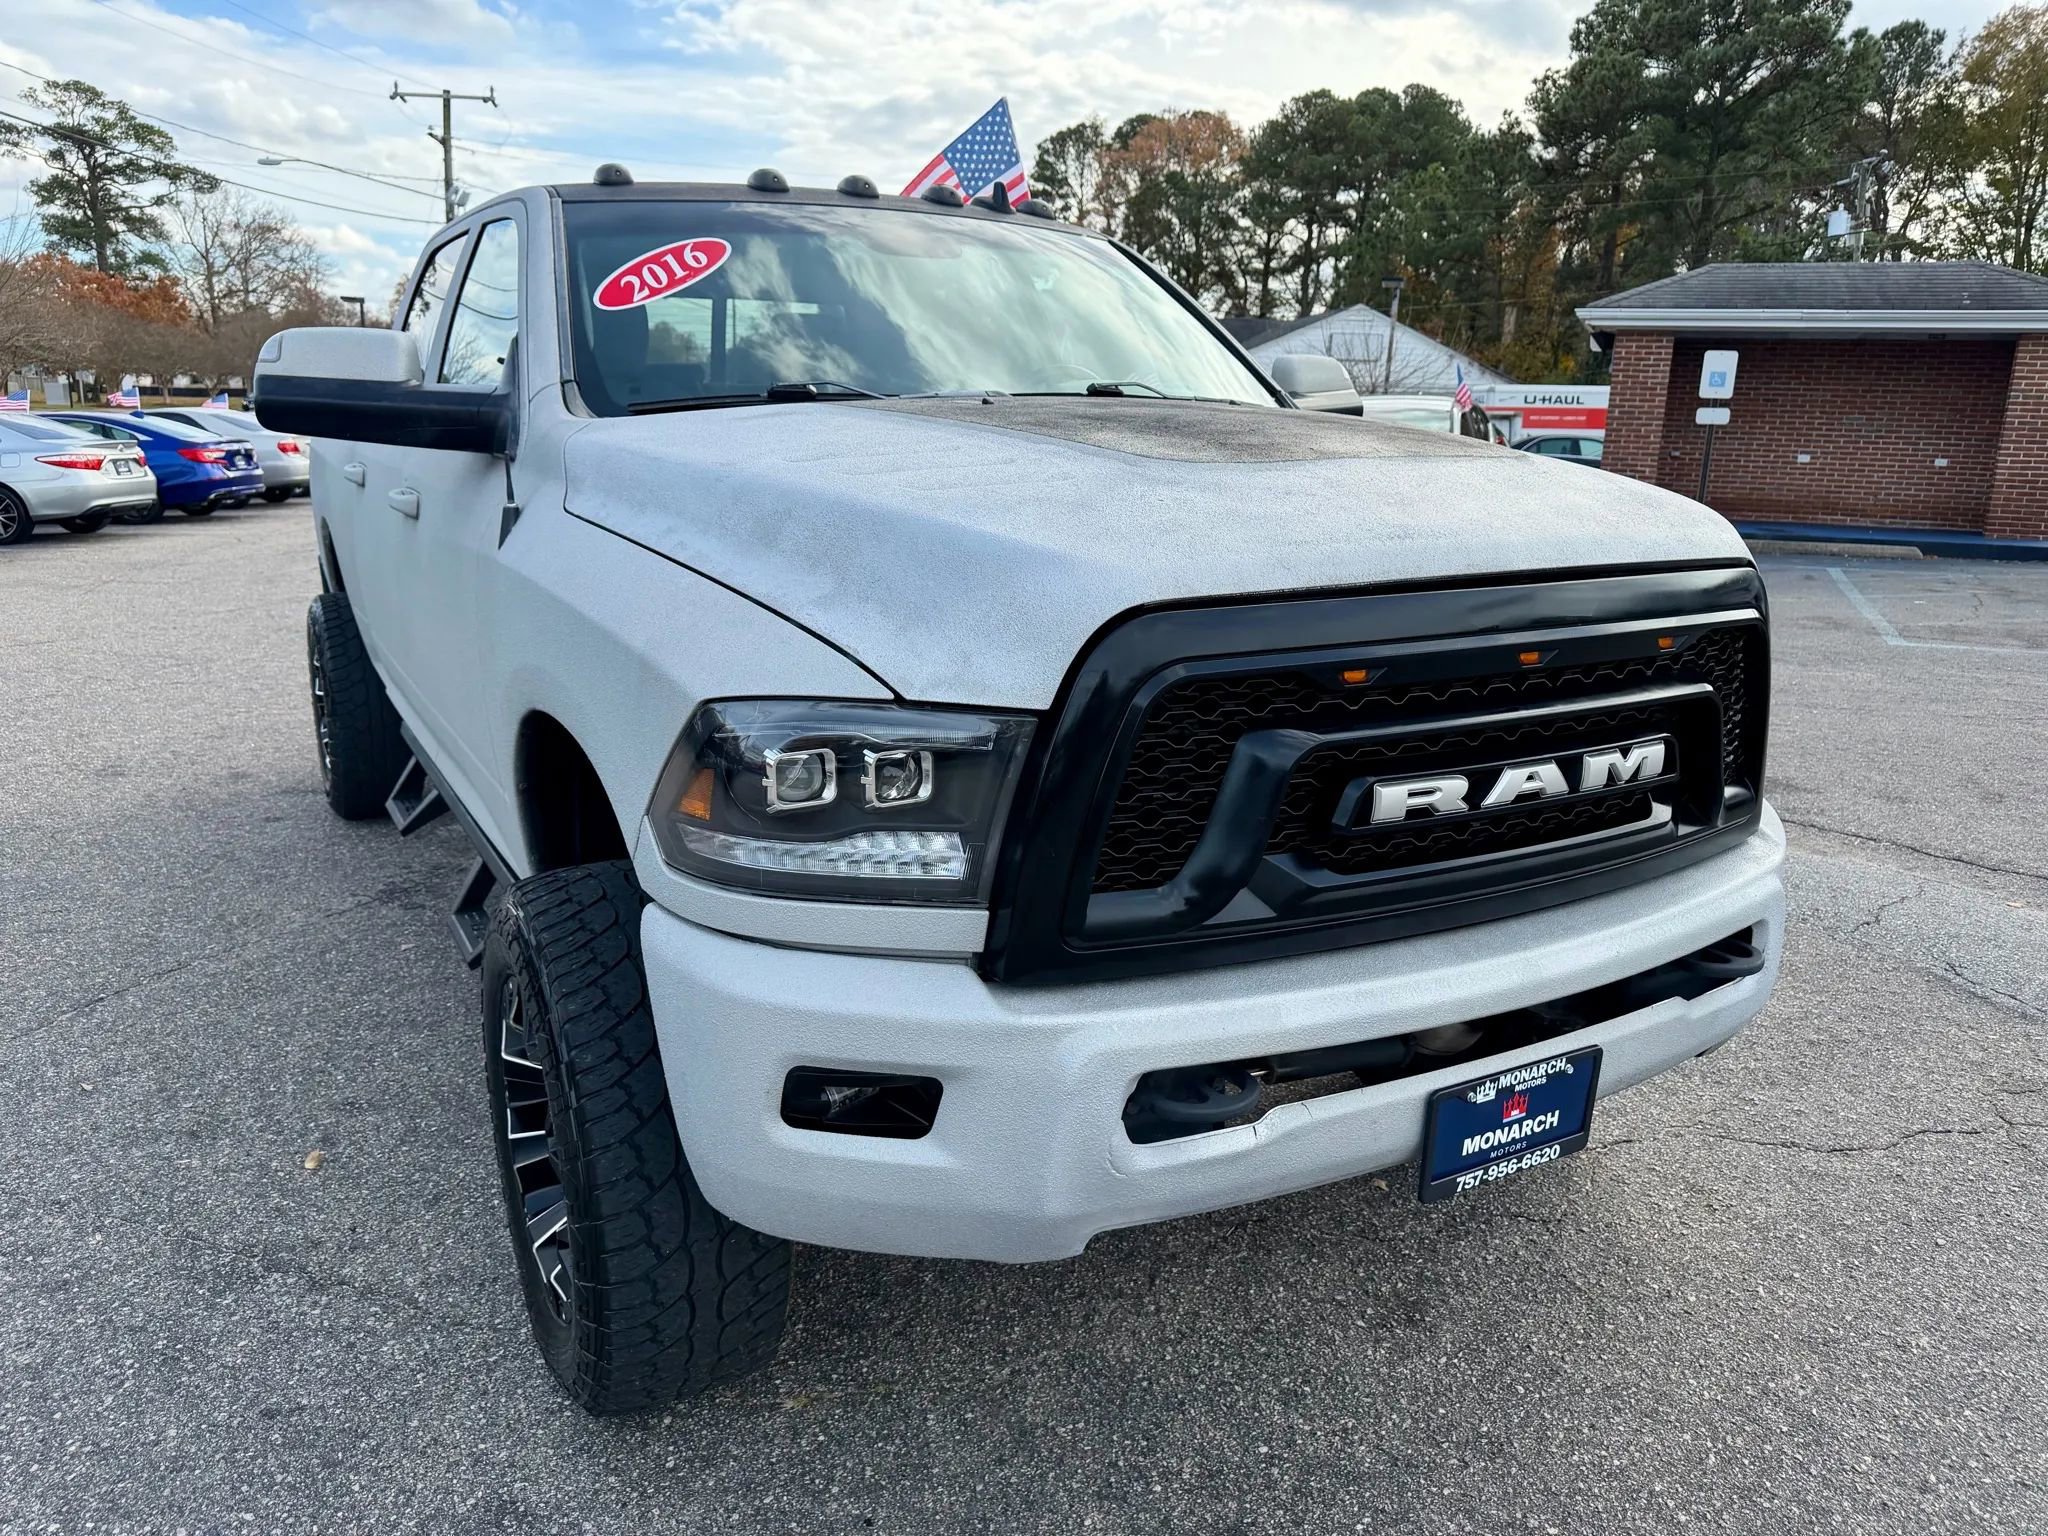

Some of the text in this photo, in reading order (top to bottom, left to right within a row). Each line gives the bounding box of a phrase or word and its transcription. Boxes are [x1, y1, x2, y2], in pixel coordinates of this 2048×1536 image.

[620, 242, 708, 303] 2016
[1524, 395, 1584, 405] U-HAUL
[1370, 740, 1665, 824] RAM
[1498, 1057, 1567, 1089] MONARCH
[1514, 1076, 1547, 1092] MOTORS
[1461, 1109, 1560, 1156] MONARCH
[1489, 1141, 1527, 1159] MOTORS
[1456, 1144, 1560, 1193] 757-956-6620
